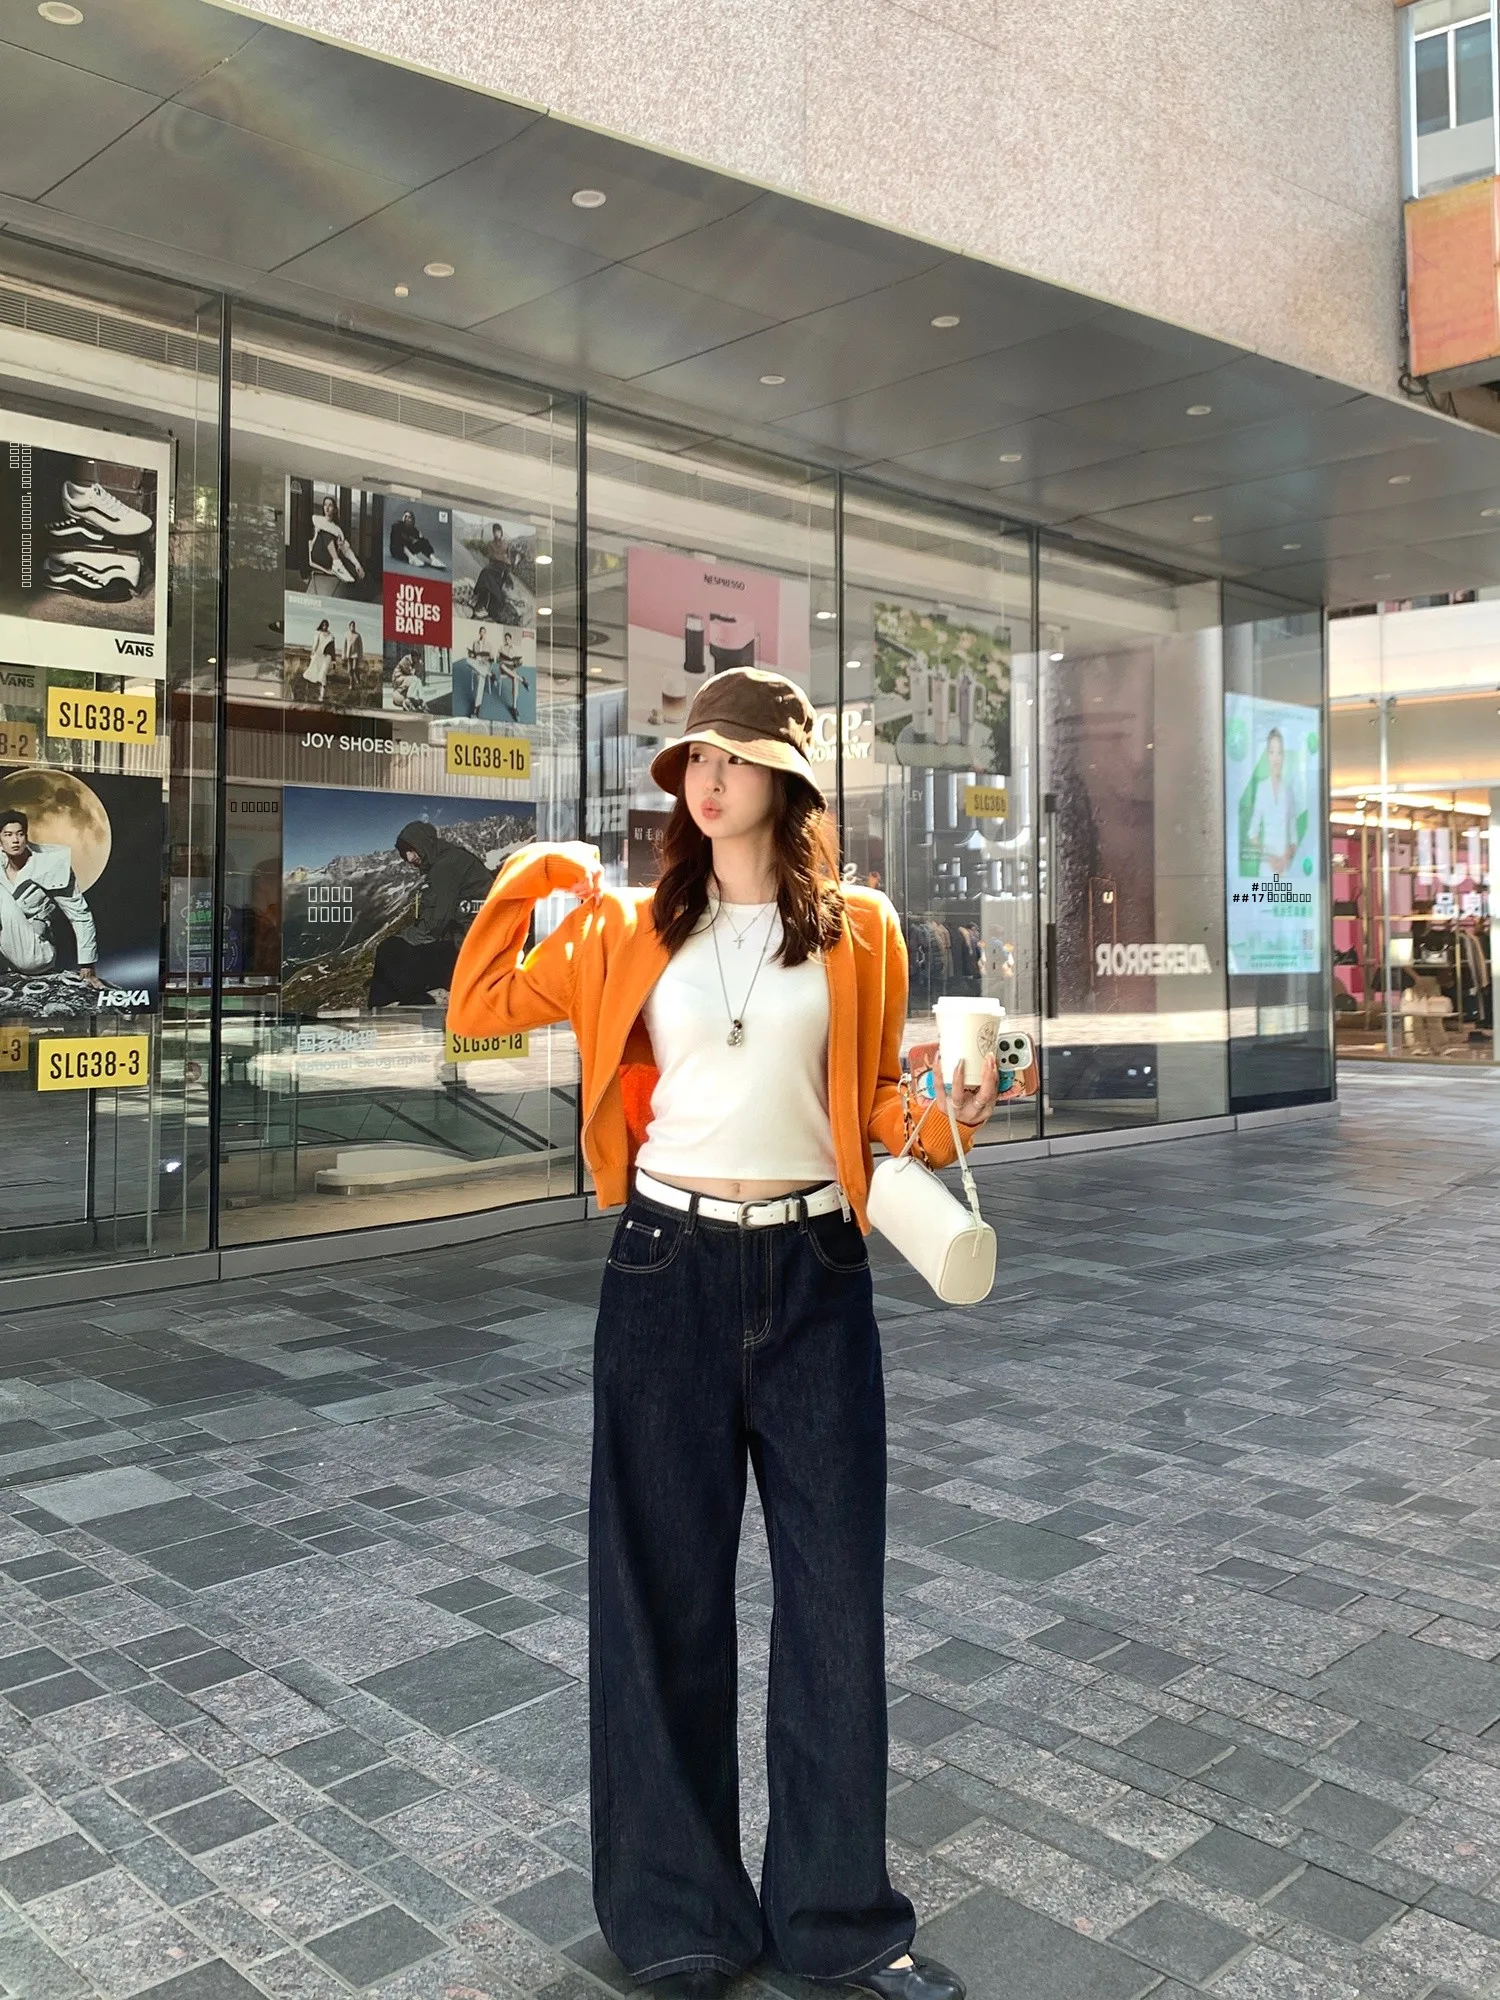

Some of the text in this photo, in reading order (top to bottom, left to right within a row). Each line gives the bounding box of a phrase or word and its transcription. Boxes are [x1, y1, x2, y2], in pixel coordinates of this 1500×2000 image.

[396, 584, 424, 602] JOY
[395, 600, 441, 622] SHOES
[395, 616, 424, 636] BAR
[115, 638, 154, 657] VANS
[59, 701, 148, 734] SLG38-2
[301, 733, 430, 757] JOY SHOES BAR
[454, 744, 525, 770] SLG38-1b
[97, 989, 150, 1007] HOKA
[297, 1029, 377, 1053] 国家地理
[50, 1050, 140, 1079] SLG38-3
